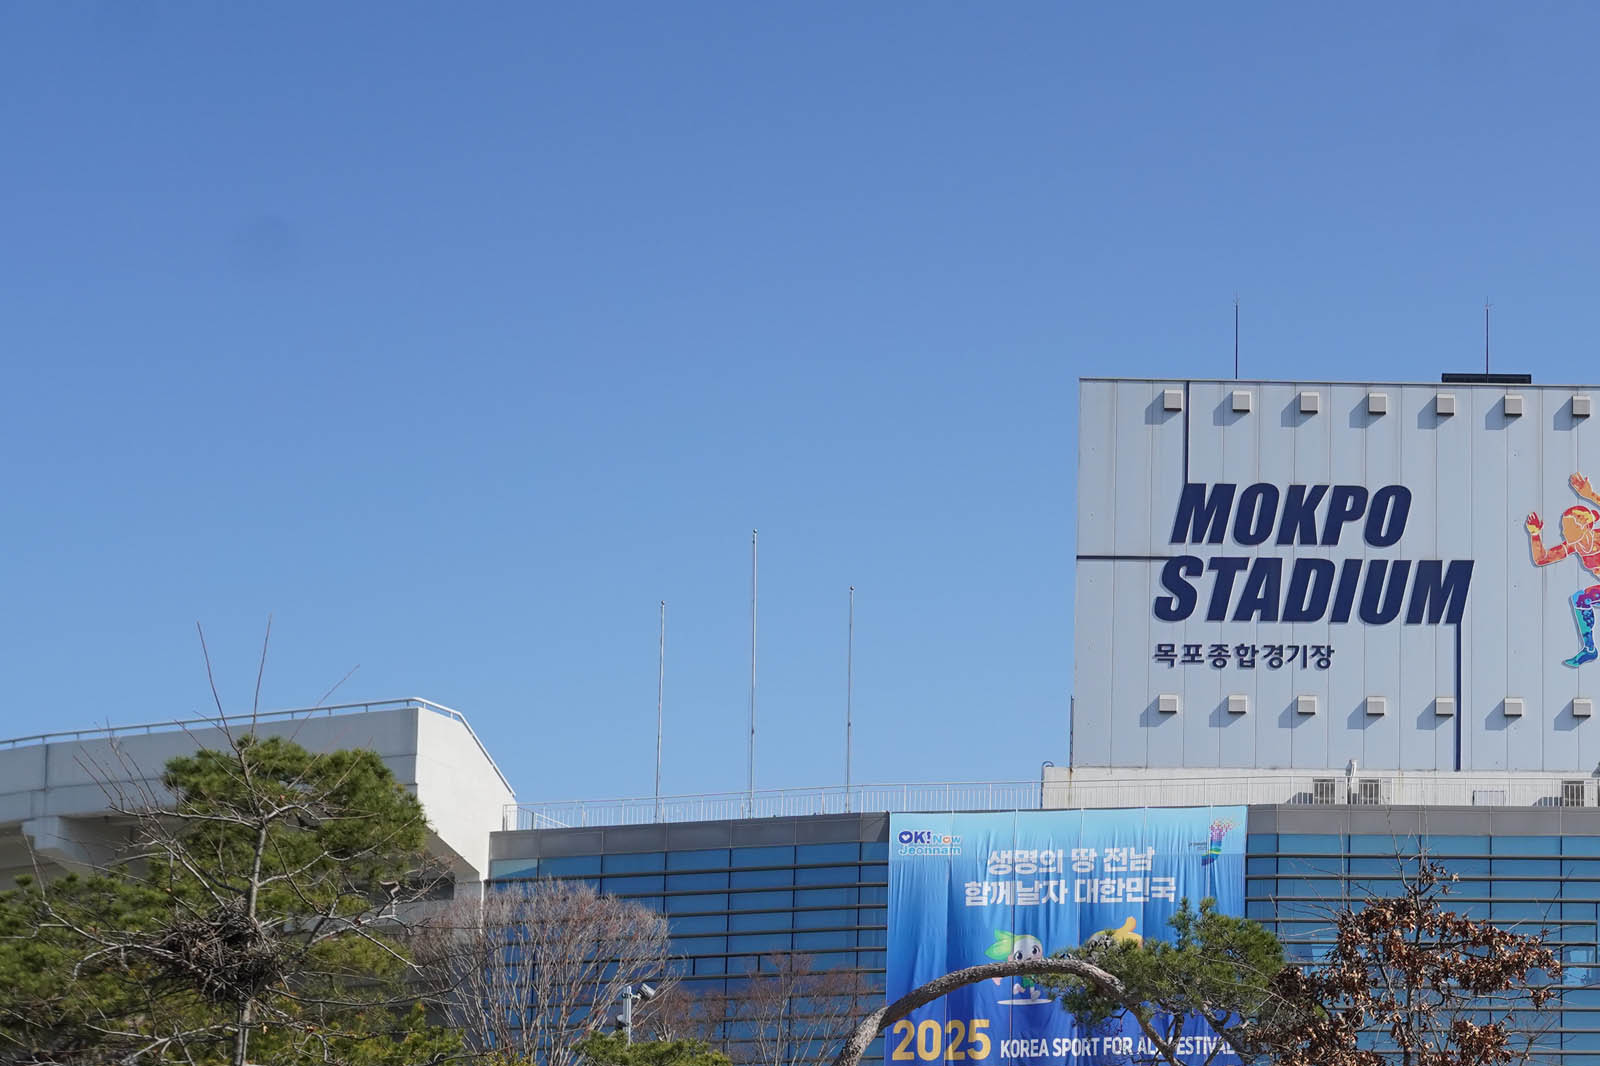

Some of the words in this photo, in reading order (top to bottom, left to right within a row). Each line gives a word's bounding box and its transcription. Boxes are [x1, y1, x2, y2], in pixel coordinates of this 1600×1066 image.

[1170, 482, 1413, 547] MOKPO
[1153, 555, 1475, 625] STADIUM
[1154, 643, 1335, 669] 목포종합경기장
[899, 831, 931, 844] OK!
[899, 845, 961, 856] Jeonnam
[988, 849, 1064, 875] 생명의
[1071, 847, 1097, 873] 땅
[1104, 846, 1156, 872] 전남
[1074, 876, 1177, 903] 대한민국
[892, 1019, 991, 1061] 2025
[1000, 1038, 1049, 1058] KOREA
[1052, 1037, 1100, 1057] SPORT
[1103, 1036, 1133, 1056] FOR
[1168, 1035, 1236, 1055] ESTIVAL
